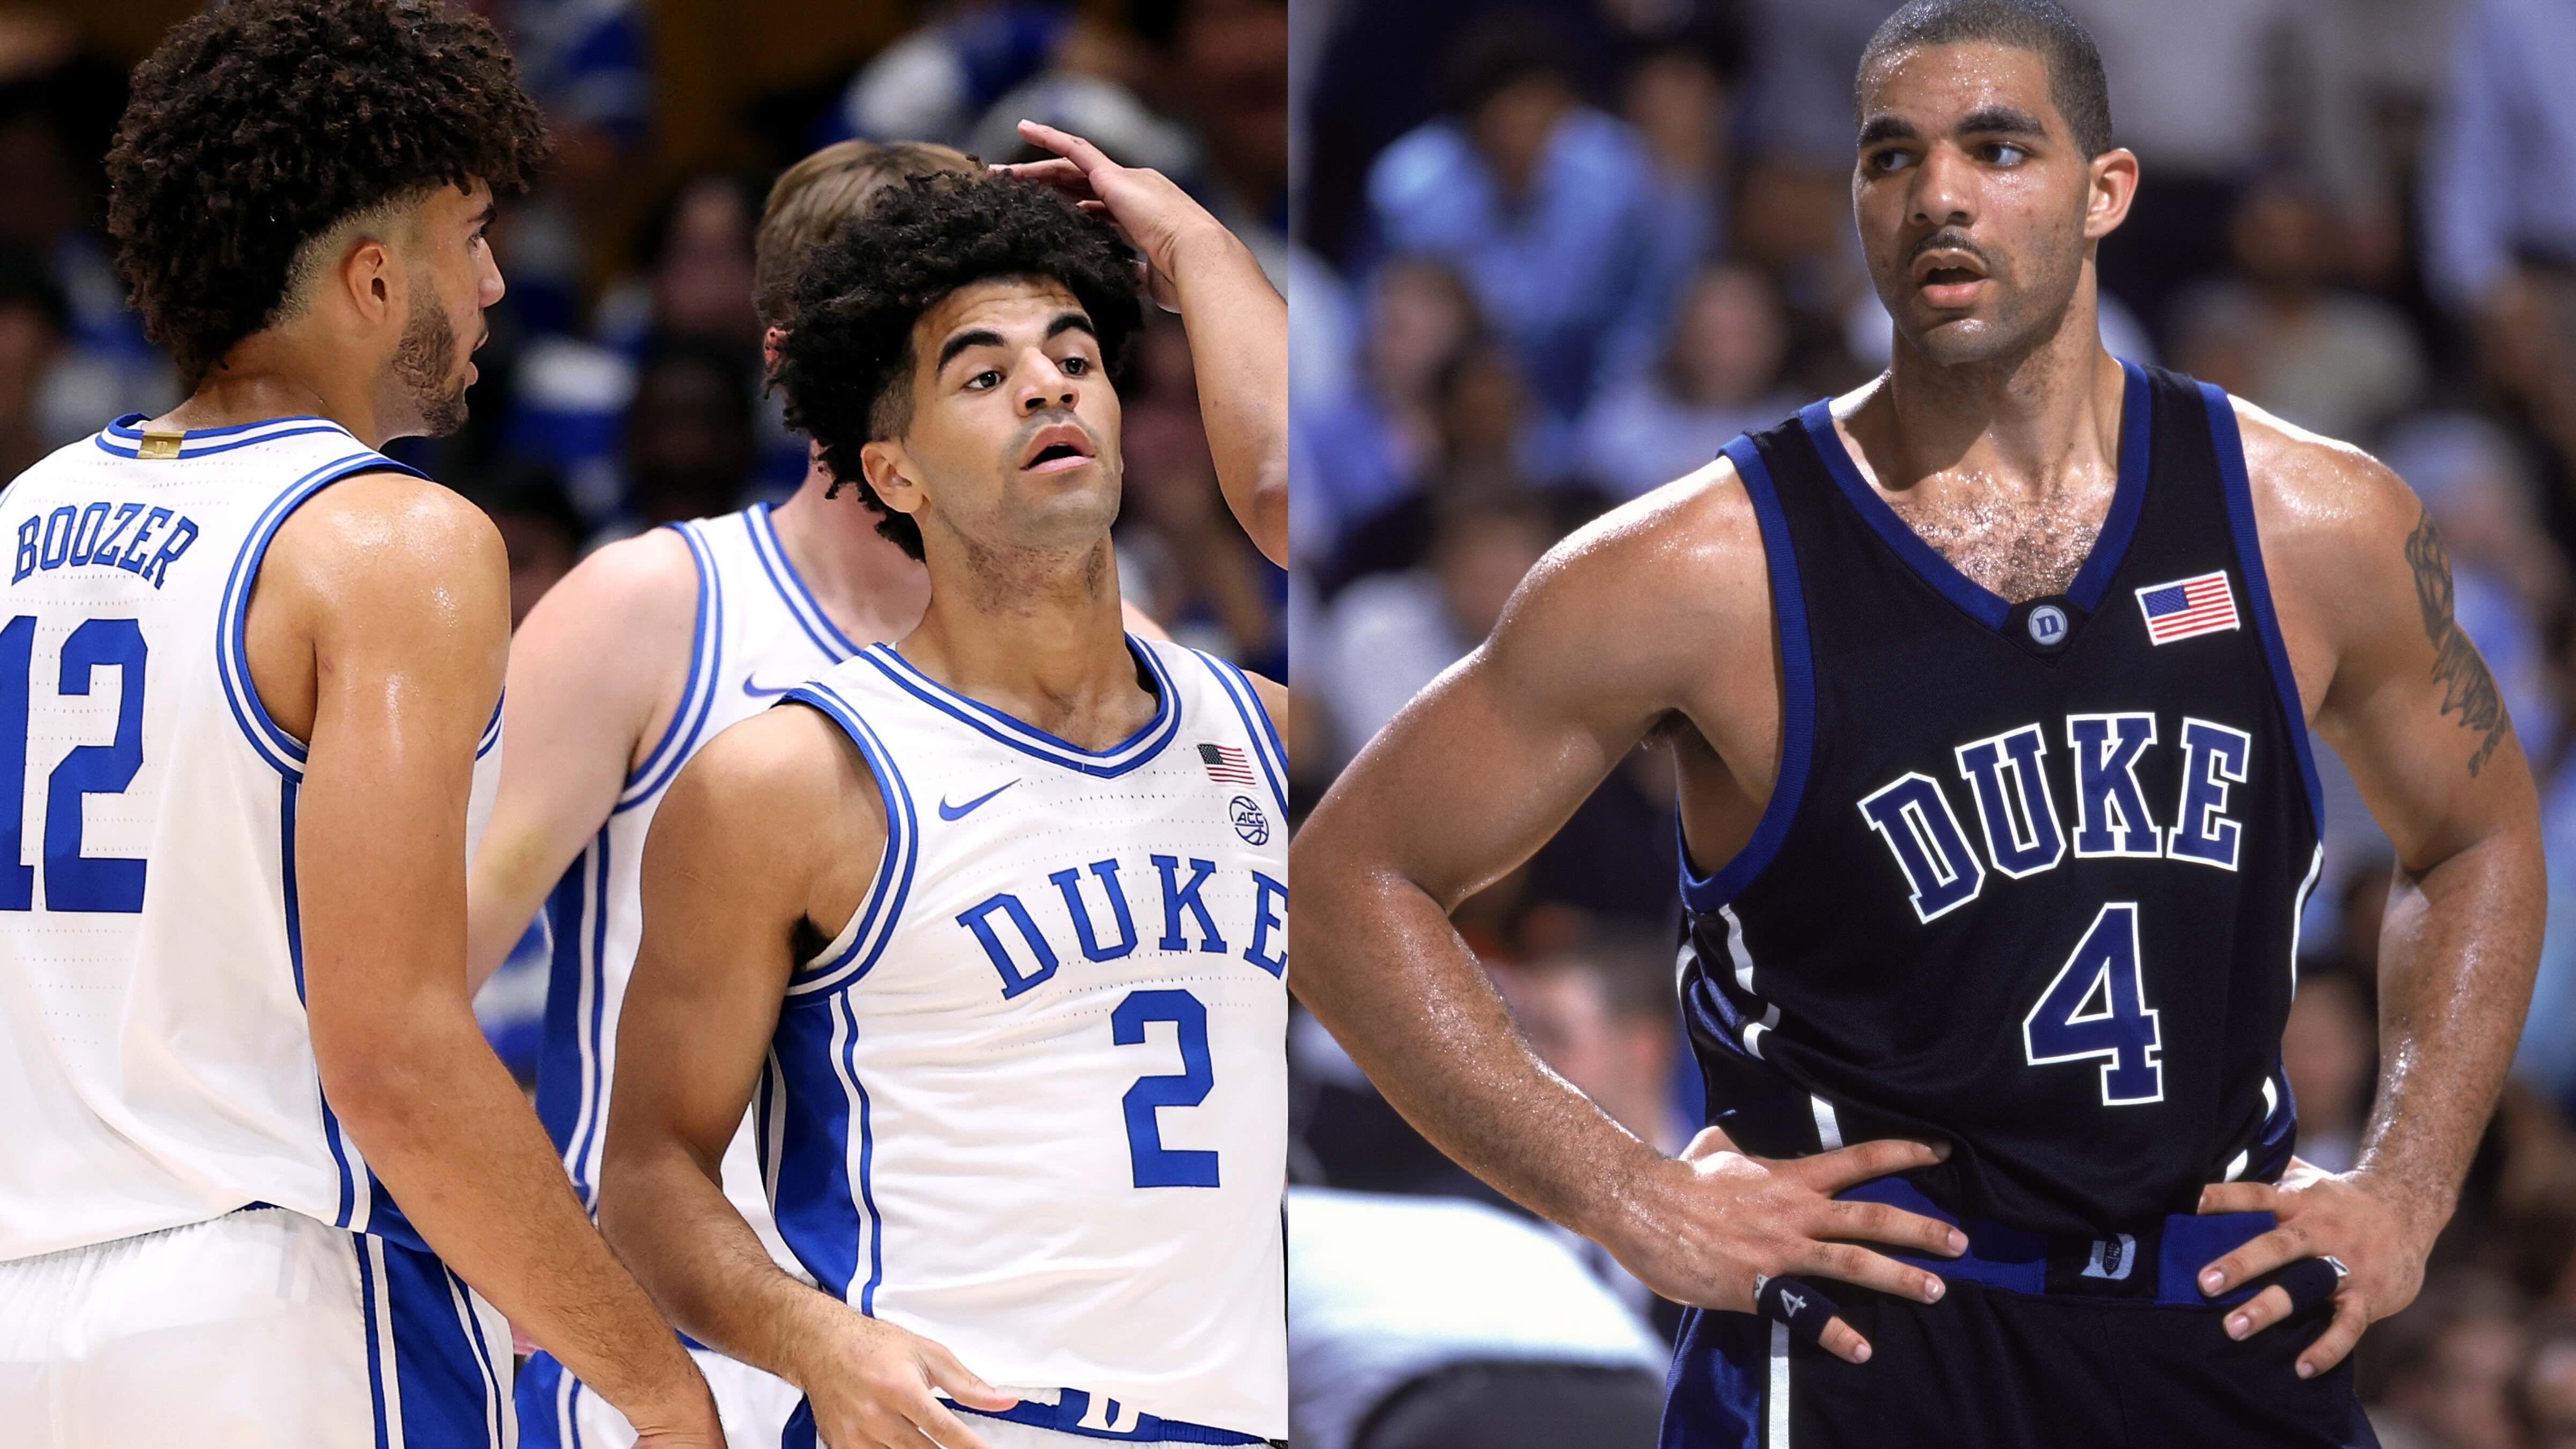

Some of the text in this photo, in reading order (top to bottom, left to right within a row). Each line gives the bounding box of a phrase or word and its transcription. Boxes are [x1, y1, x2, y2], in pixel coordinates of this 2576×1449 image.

[11, 502, 199, 590] BOOZER
[2036, 615, 2060, 638] D
[0, 614, 149, 913] 12
[1237, 811, 1264, 824] ACC
[1856, 712, 2251, 924] DUKE
[955, 854, 1288, 999] DUKE
[2023, 902, 2164, 1106] 4
[1111, 989, 1220, 1188] 2
[1780, 1288, 1807, 1318] 4
